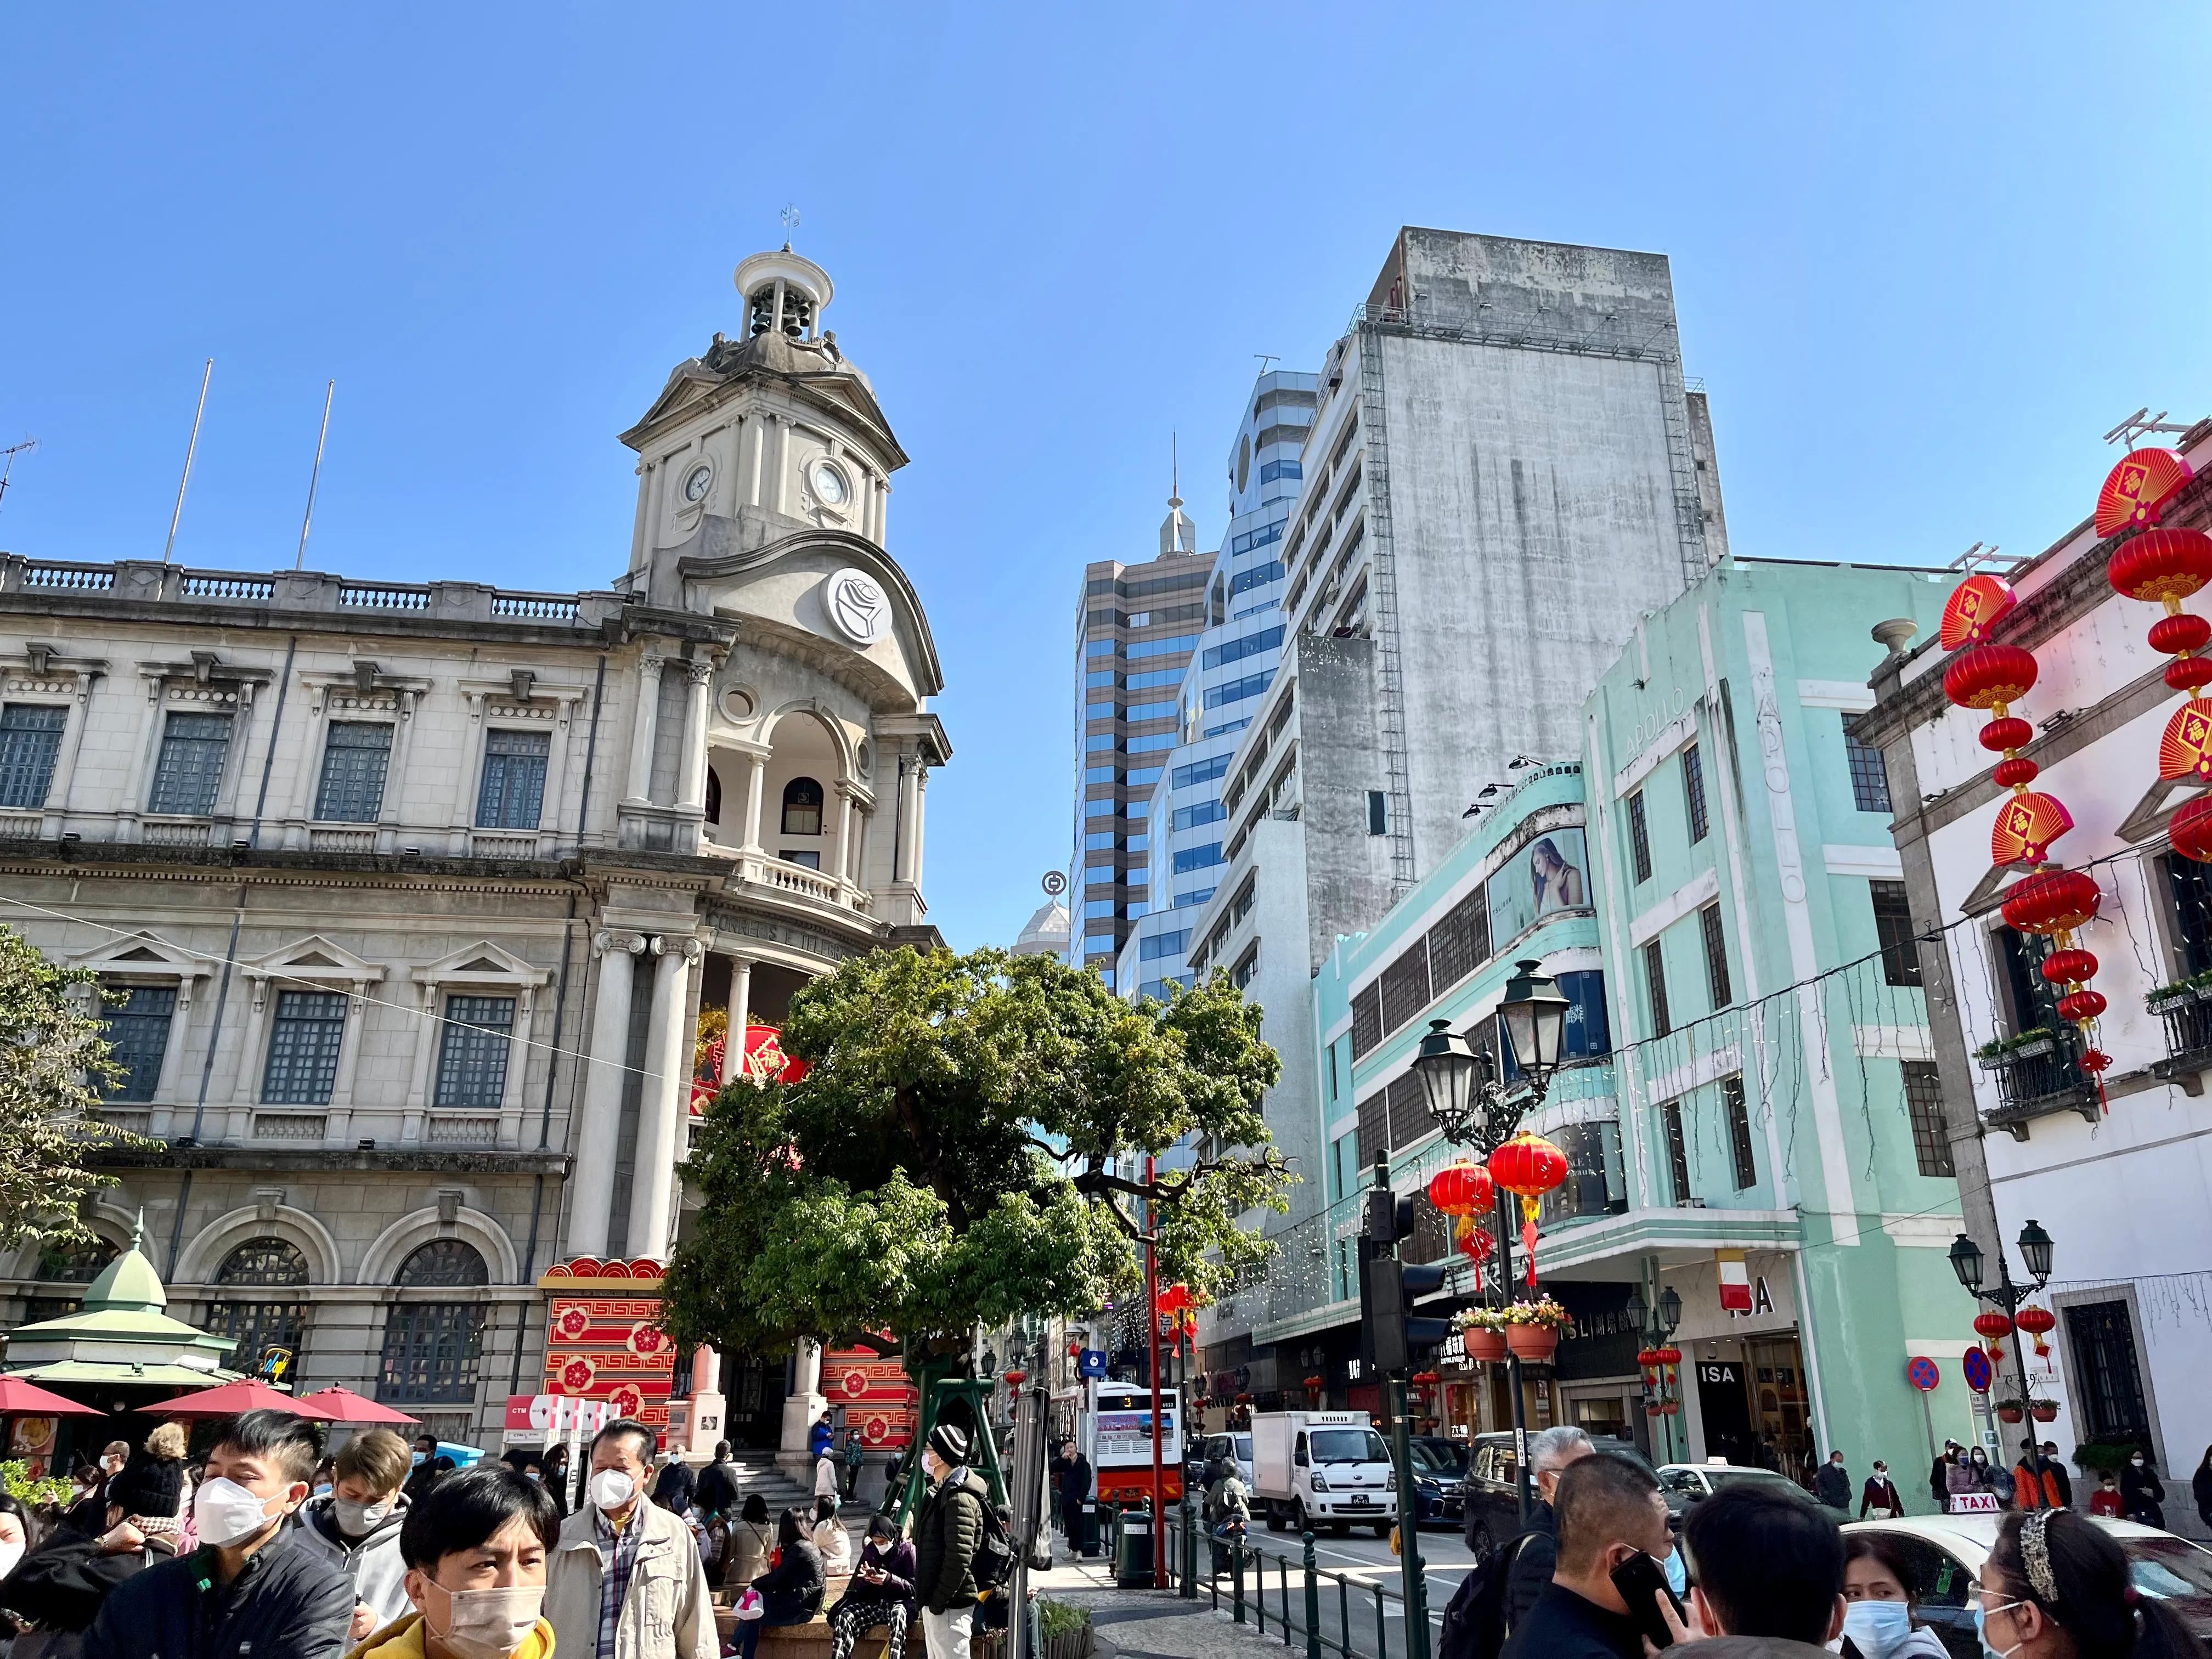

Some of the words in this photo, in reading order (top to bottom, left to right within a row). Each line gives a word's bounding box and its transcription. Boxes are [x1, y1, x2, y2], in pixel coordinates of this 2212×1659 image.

[2124, 469, 2141, 495] 福
[1963, 593, 1977, 615] 福
[1626, 686, 1685, 758] APOLLO
[2187, 718, 2205, 743] 福
[2013, 811, 2028, 833] 福
[760, 1048, 781, 1068] 福
[1701, 1367, 1735, 1383] ISA
[1960, 1496, 1996, 1509] TAXI
